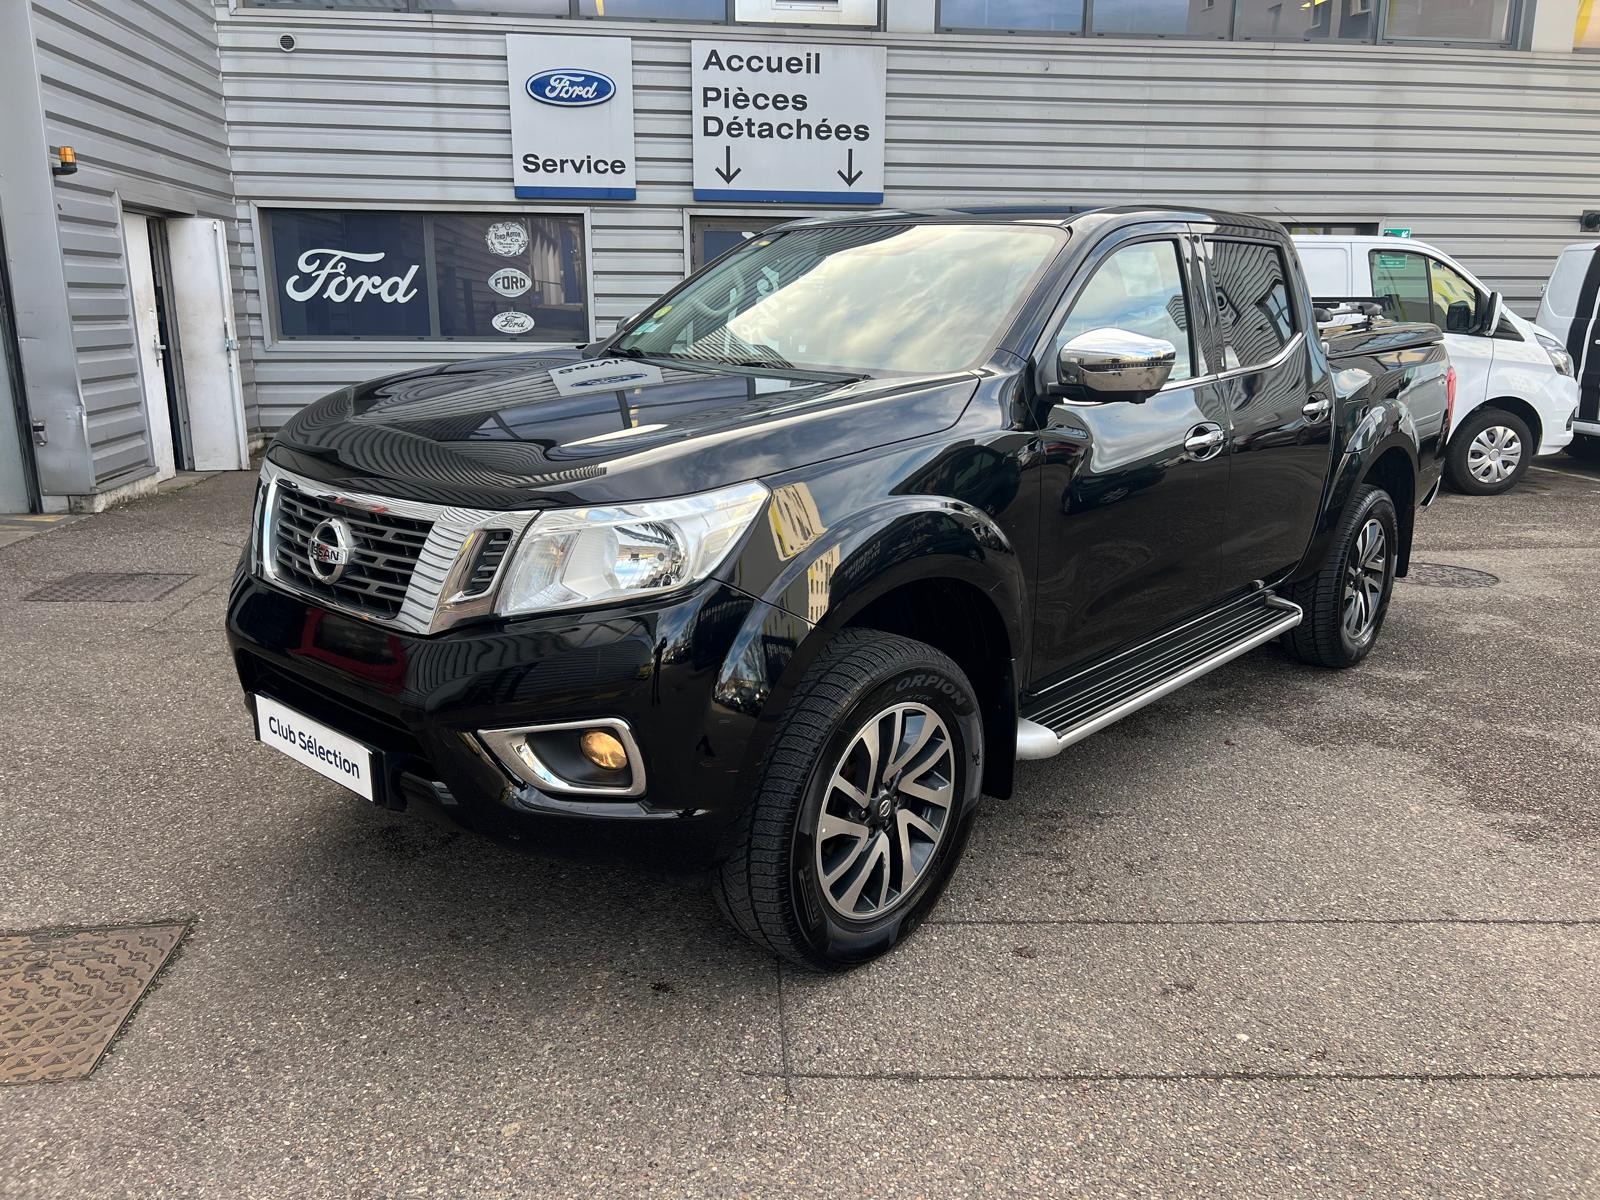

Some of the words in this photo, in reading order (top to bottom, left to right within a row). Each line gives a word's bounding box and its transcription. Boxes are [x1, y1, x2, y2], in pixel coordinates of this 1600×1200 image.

[703, 49, 821, 74] Accueil
[545, 75, 598, 98] Ford
[703, 87, 808, 111] Pièces
[703, 116, 870, 141] Détachées
[522, 153, 626, 175] Service
[286, 249, 419, 303] Ford
[494, 275, 525, 290] FORD
[500, 315, 526, 328] Ford
[268, 716, 296, 744] Club
[298, 730, 360, 779] Sélection
